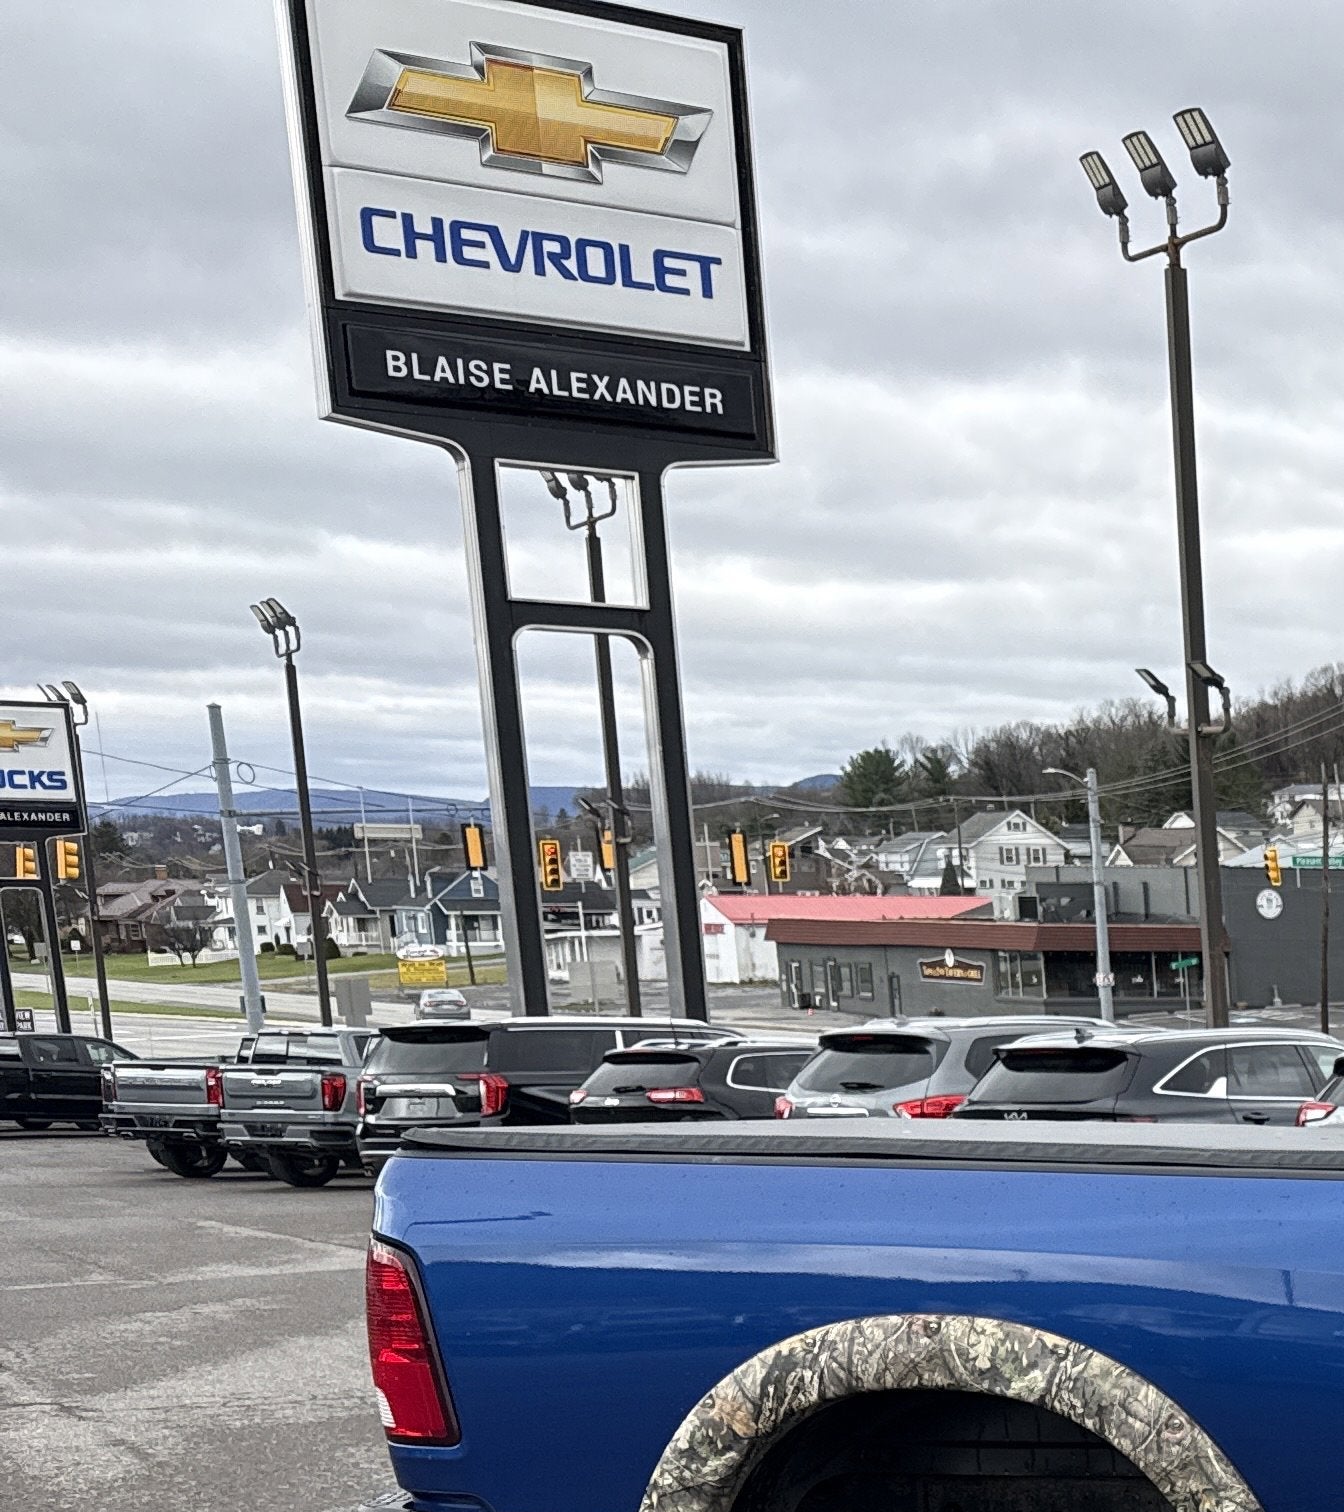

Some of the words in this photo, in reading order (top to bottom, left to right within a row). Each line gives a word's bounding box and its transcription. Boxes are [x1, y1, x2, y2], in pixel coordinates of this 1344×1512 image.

[359, 206, 722, 299] CHEVROLET
[385, 350, 513, 390] BLAISE
[529, 367, 724, 415] ALEXANDER
[0, 769, 67, 790] CKS
